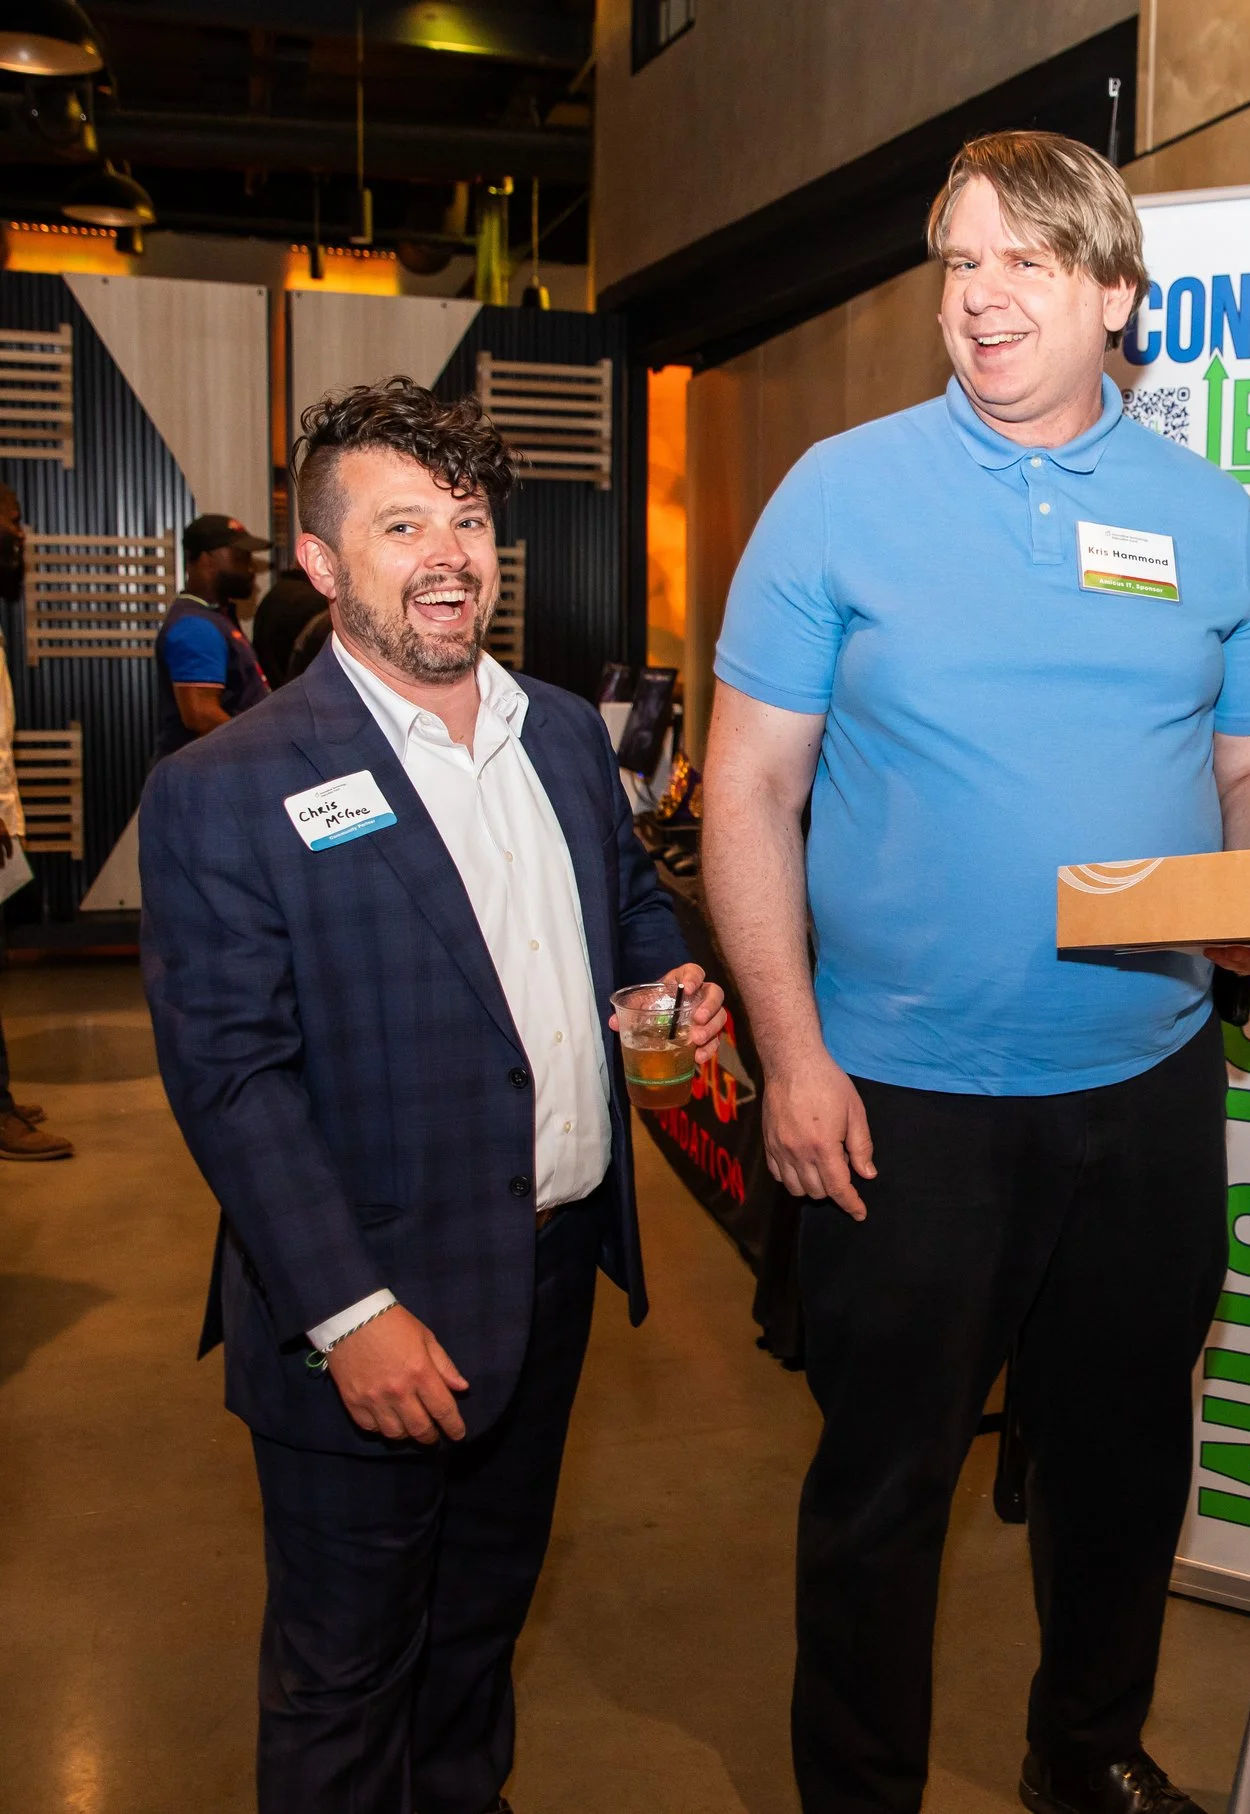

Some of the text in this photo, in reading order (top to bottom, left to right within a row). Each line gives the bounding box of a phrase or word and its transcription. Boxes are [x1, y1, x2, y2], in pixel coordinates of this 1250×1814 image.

[1088, 546, 1169, 566] Kris Hammond
[325, 806, 371, 828] McGee
